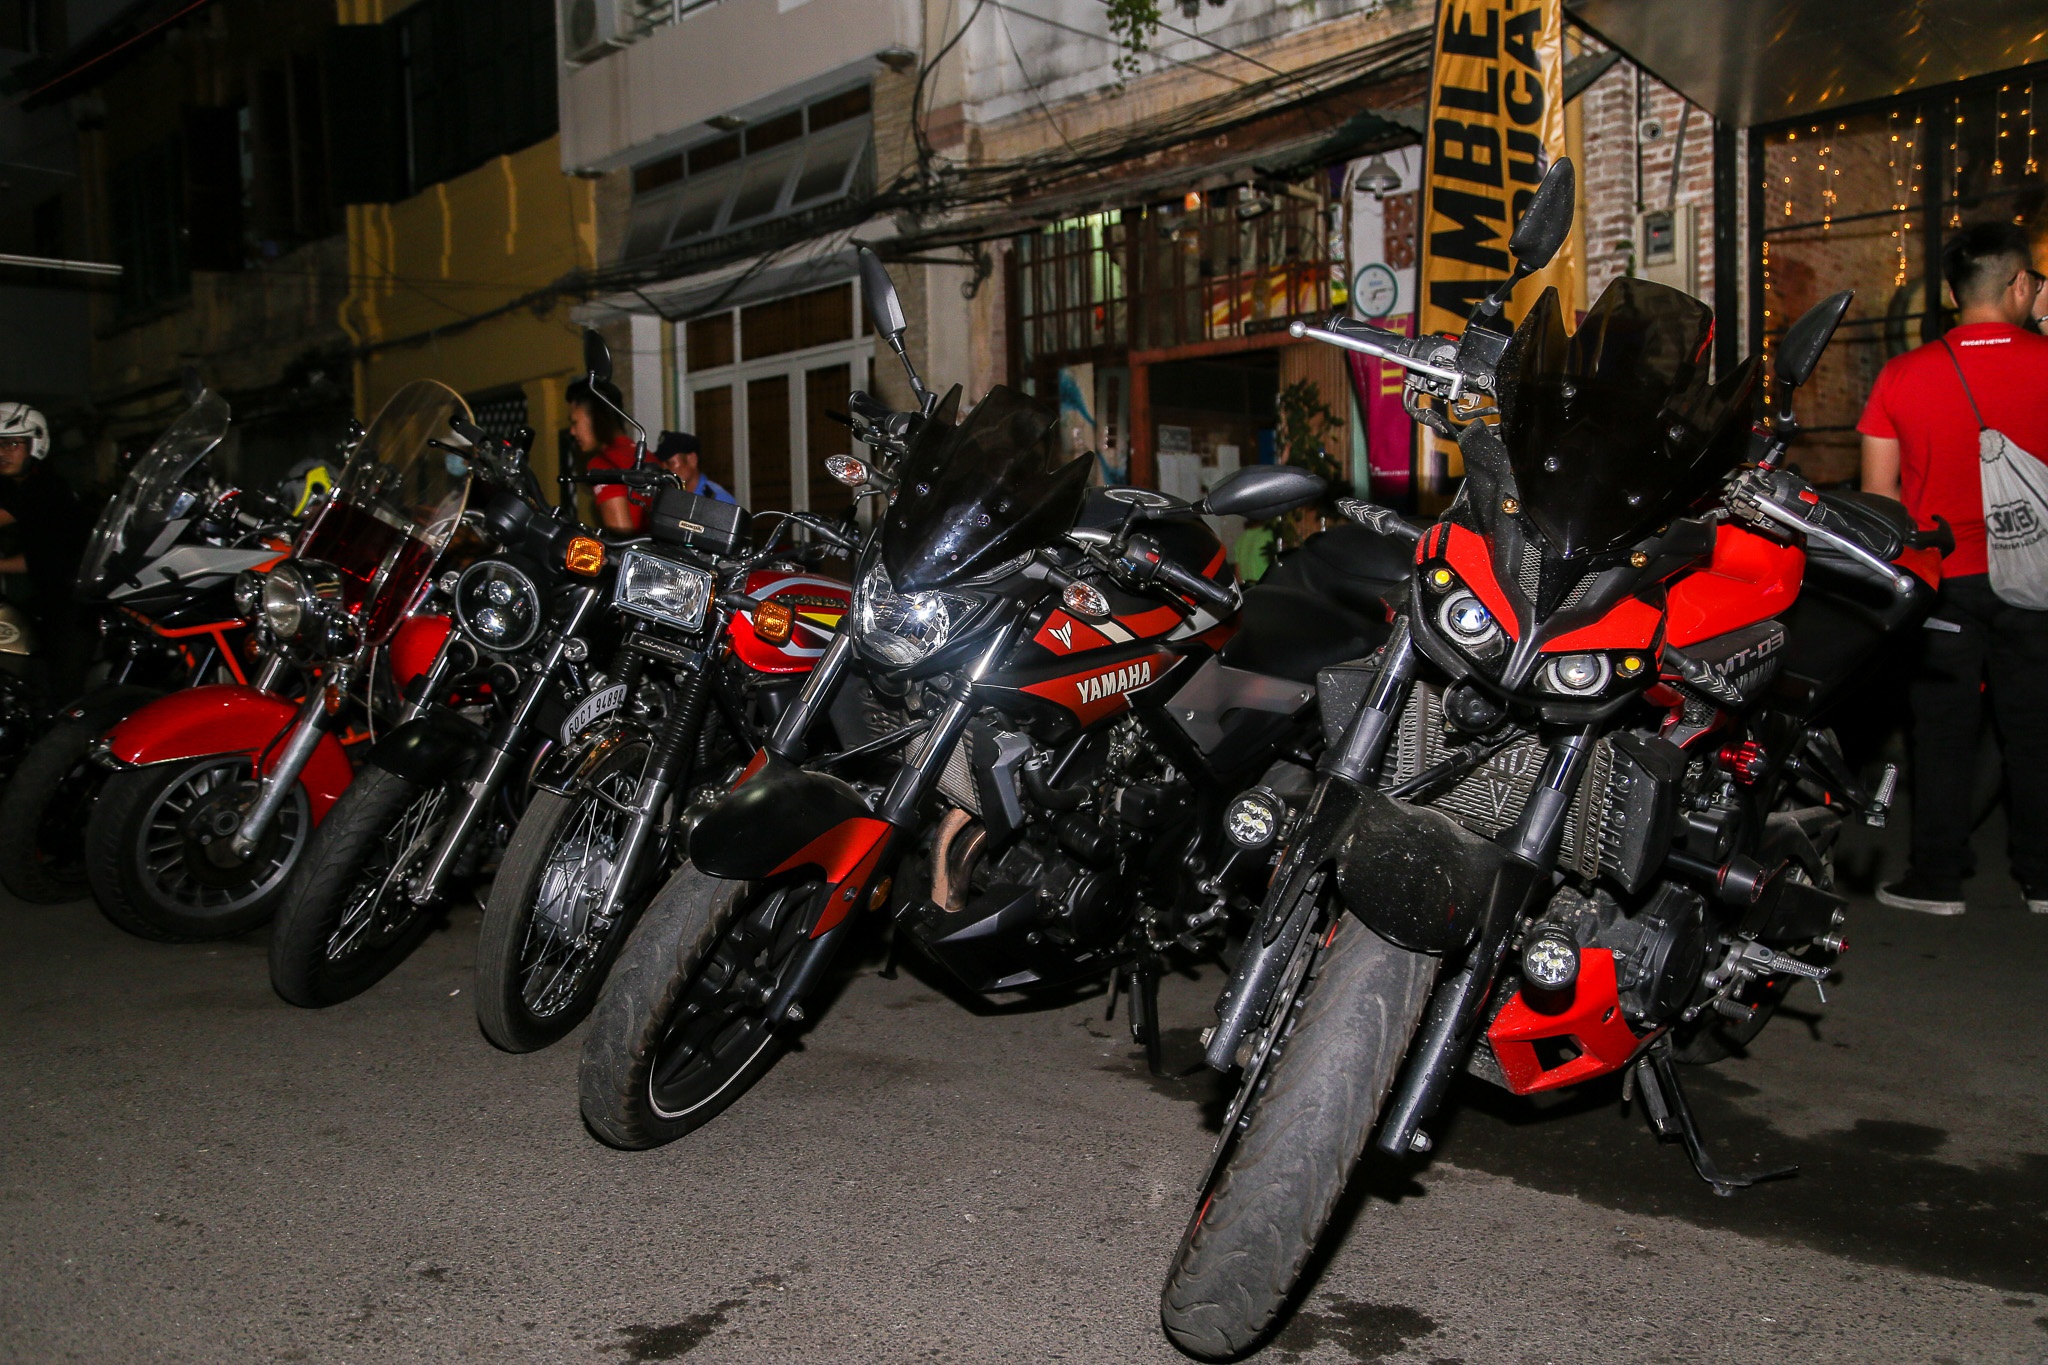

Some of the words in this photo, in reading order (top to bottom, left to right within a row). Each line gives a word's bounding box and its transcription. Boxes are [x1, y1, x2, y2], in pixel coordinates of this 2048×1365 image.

[1504, 0, 1547, 226] UCA
[1715, 630, 1784, 676] MT-03
[1076, 661, 1151, 704] YAMAHA
